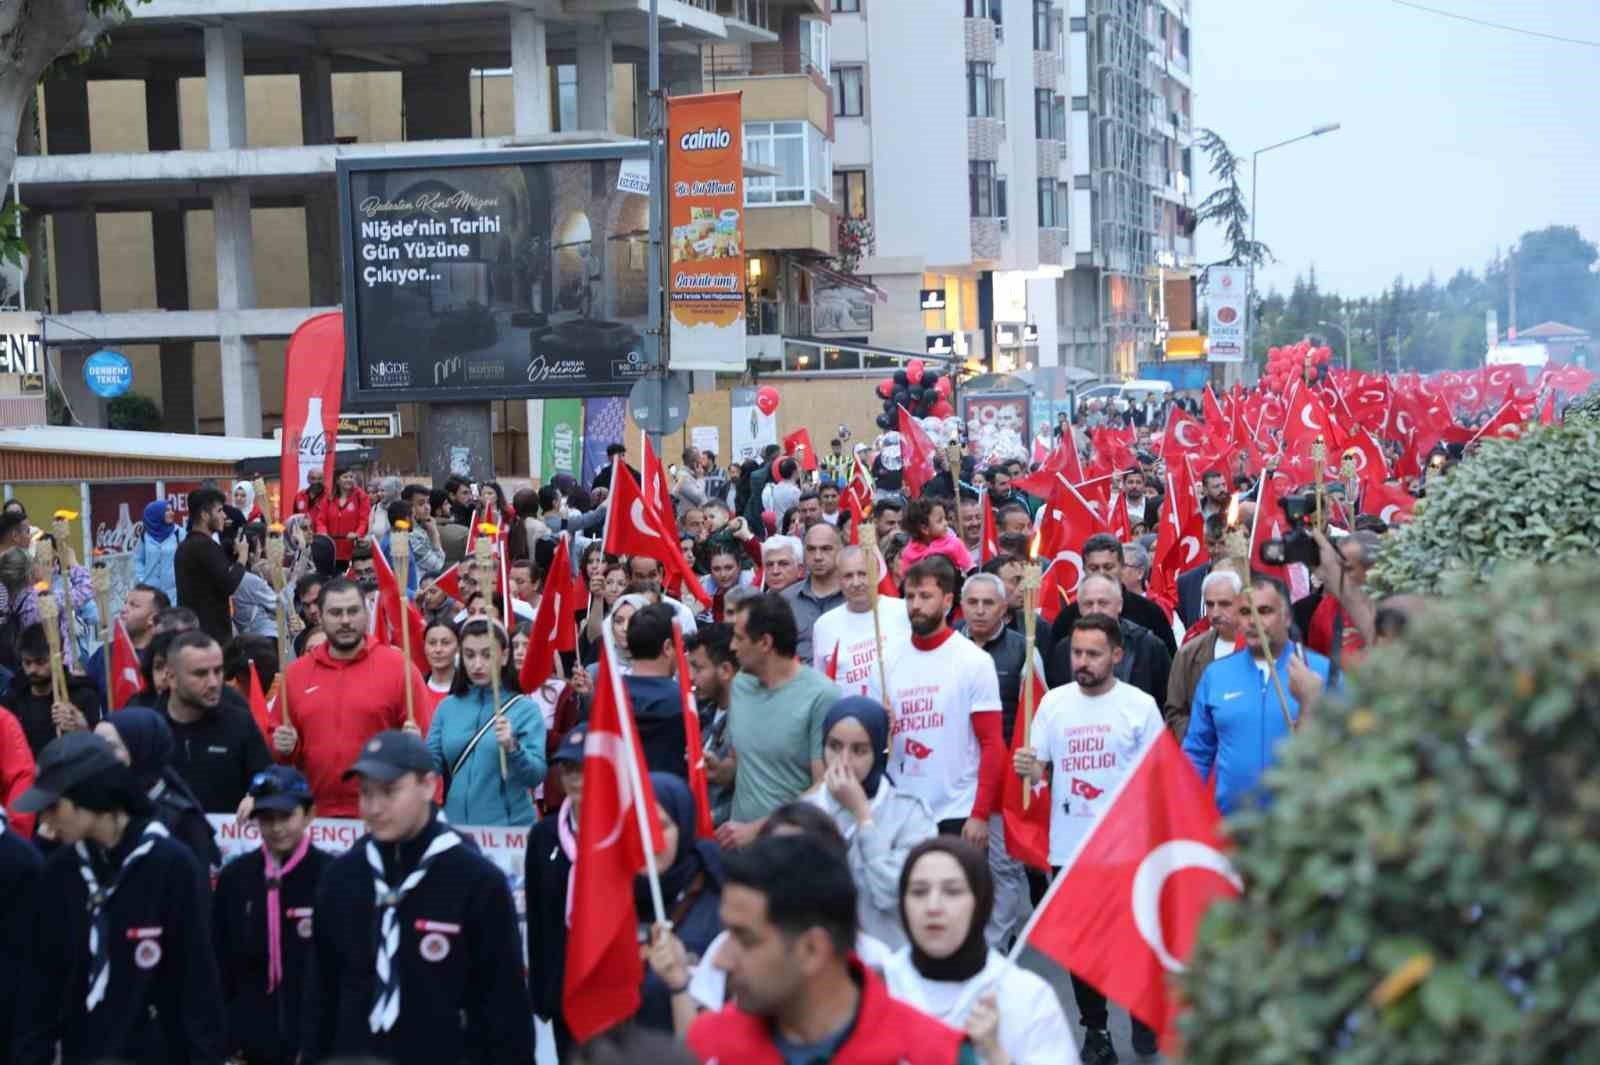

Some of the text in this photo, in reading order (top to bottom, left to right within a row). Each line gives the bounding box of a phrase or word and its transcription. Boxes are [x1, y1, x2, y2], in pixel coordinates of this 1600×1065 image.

[416, 192, 448, 213] Kent
[361, 215, 501, 241] Niğde'nin Tarihi
[362, 242, 470, 260] Gün Yüzüne
[363, 266, 441, 287] Çıkıyor...
